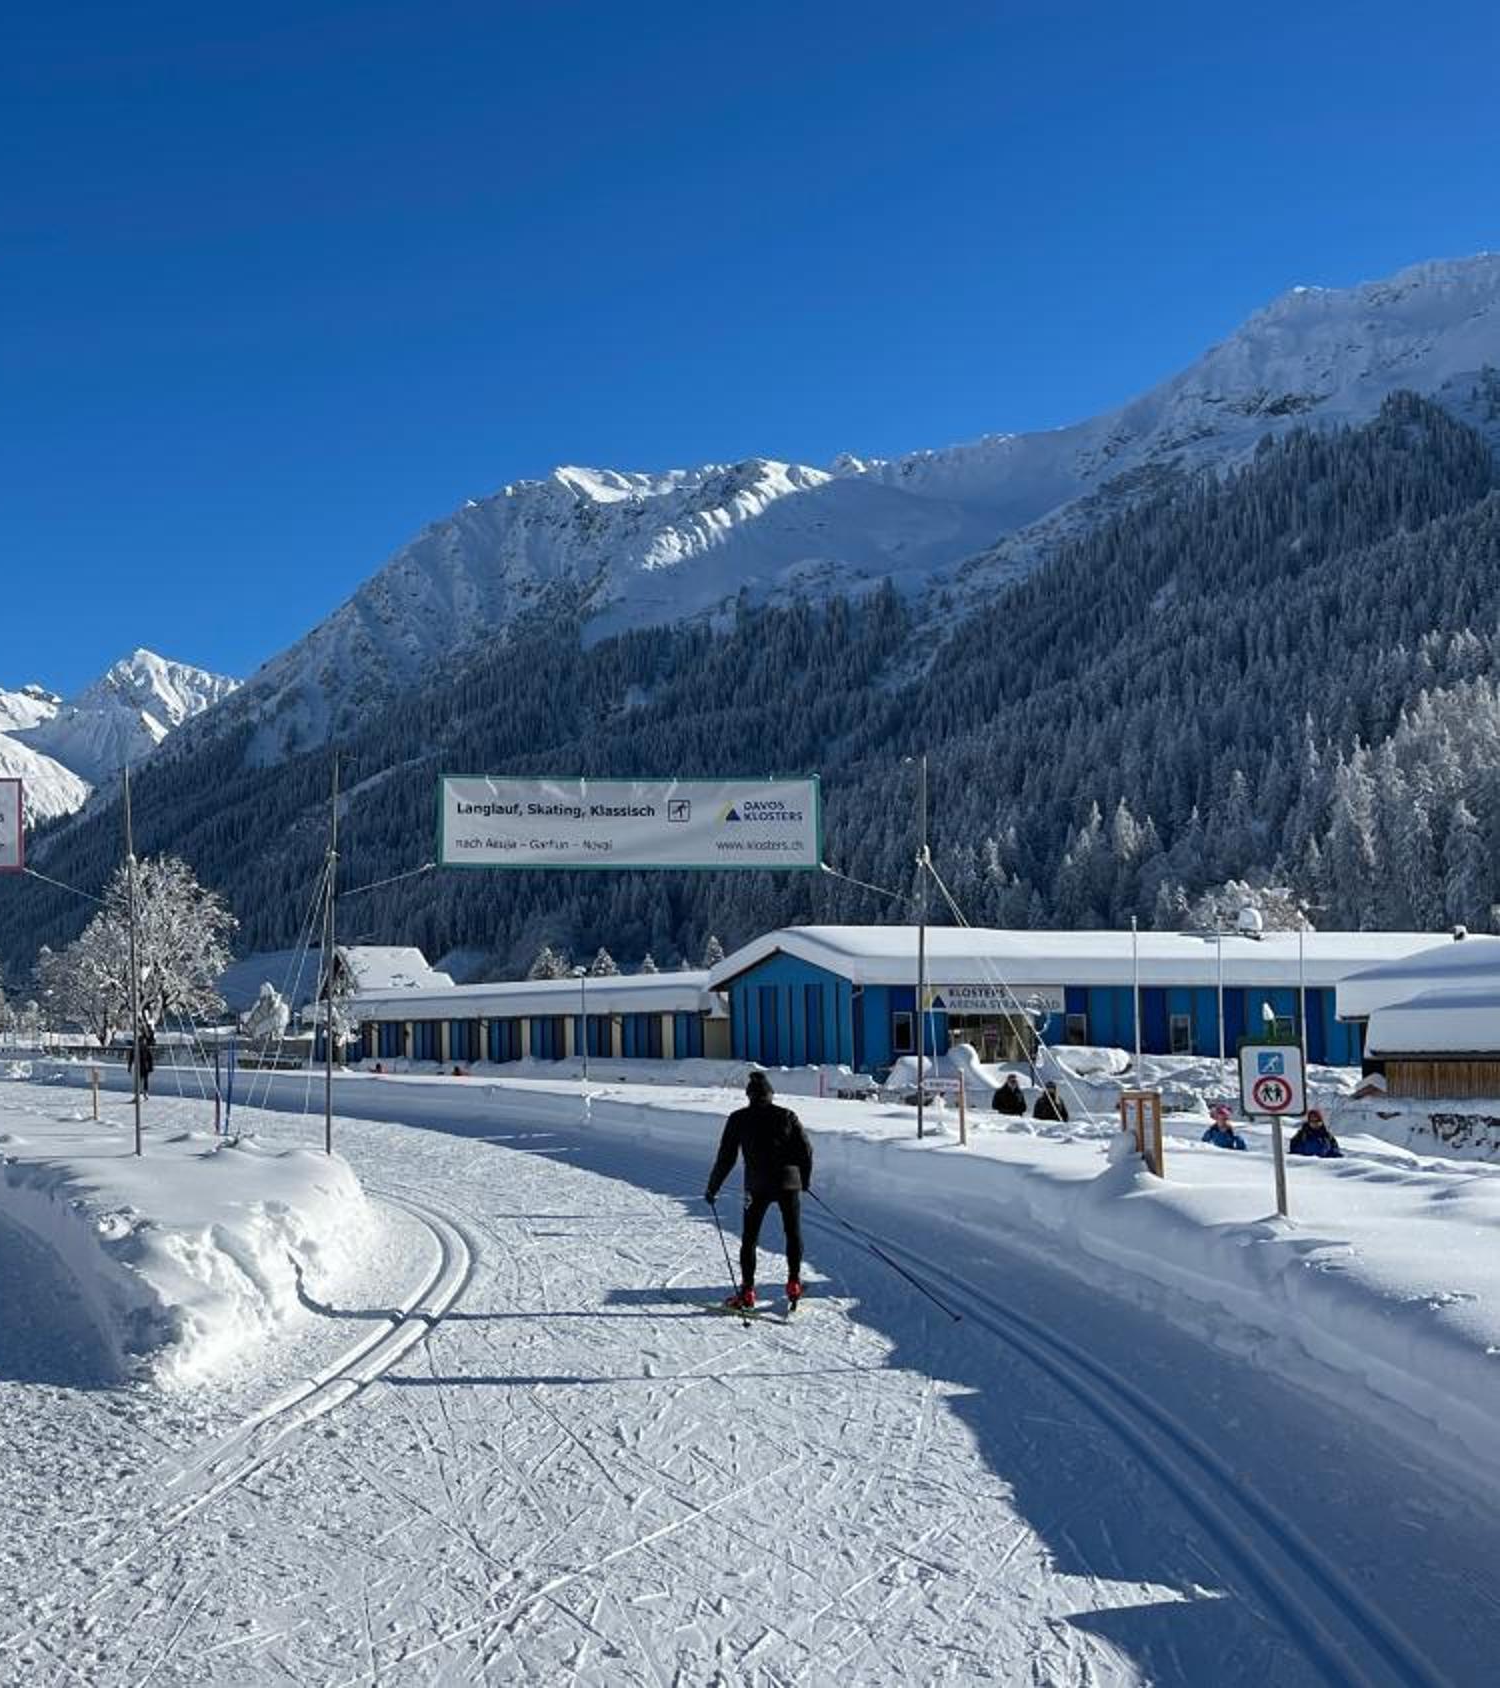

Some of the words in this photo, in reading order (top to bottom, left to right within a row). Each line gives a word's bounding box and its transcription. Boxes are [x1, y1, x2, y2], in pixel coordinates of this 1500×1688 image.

[457, 803, 523, 816] Langlauf,
[527, 803, 587, 818] Skating,
[590, 804, 655, 817] Klassisch
[743, 801, 785, 811] DAVOS
[743, 811, 803, 821] KLOSTERS
[456, 838, 482, 849] nach
[715, 840, 805, 851] www.klosters.ch
